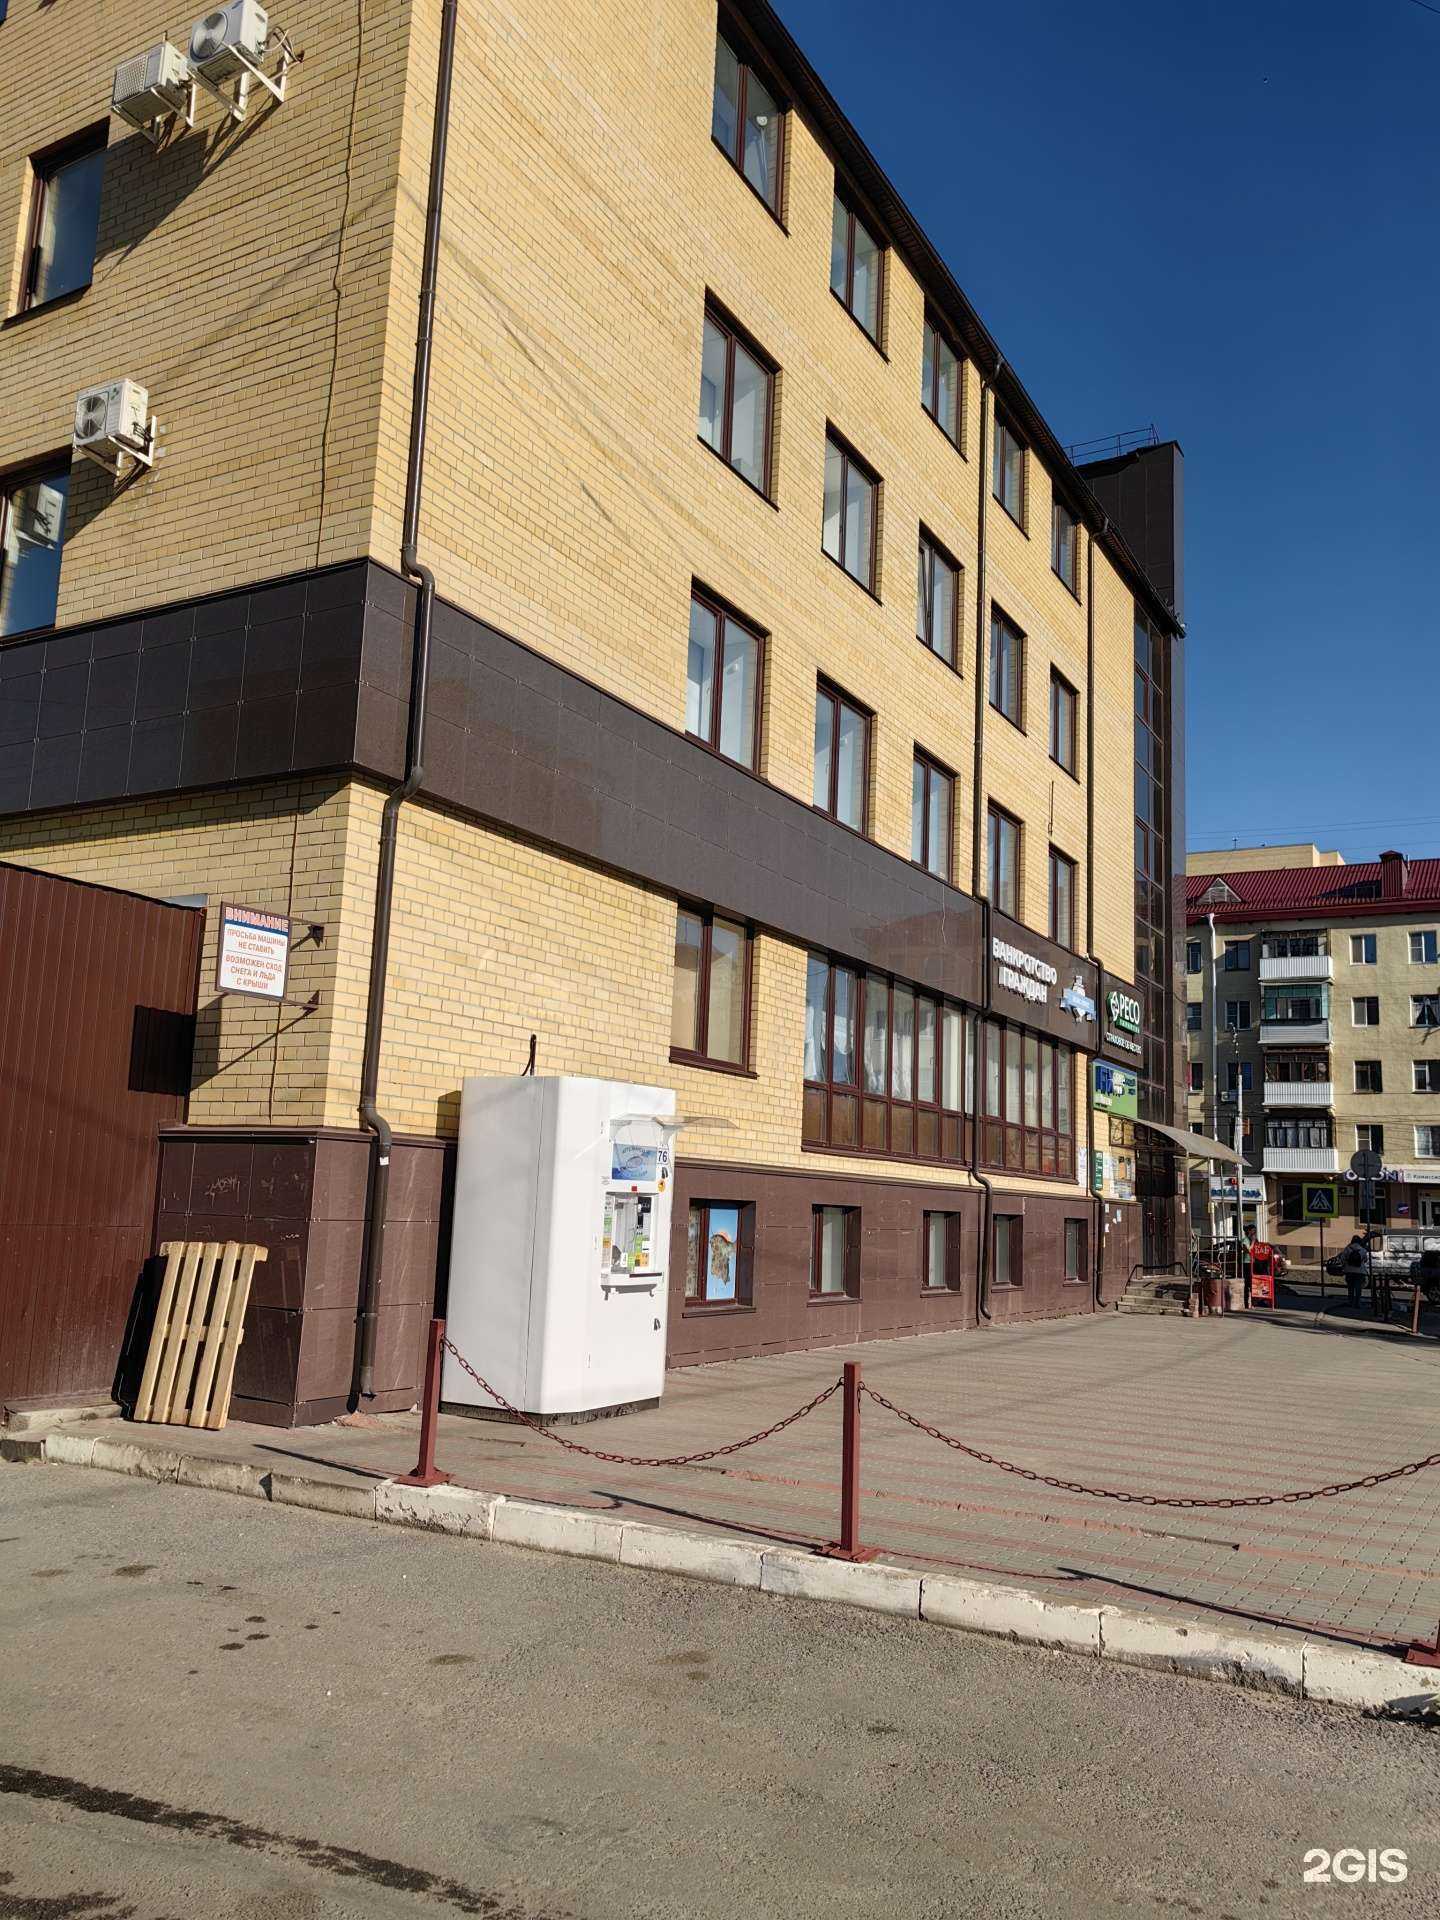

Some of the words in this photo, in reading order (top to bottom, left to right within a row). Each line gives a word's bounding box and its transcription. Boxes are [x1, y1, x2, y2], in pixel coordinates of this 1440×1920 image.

[225, 906, 289, 932] ВНИМАНИЕ
[226, 928, 257, 941] ПРОСЬБА
[258, 935, 286, 947] МАШИНЫ
[238, 941, 247, 950] НЕ
[248, 943, 275, 955] СТАВИТЬ
[225, 954, 264, 970] ВОЗМОЖЕН
[265, 962, 282, 973] СХОД
[992, 937, 1058, 985] БАНКРОТСТВО
[230, 965, 252, 977] СНЕГА
[253, 970, 259, 978] И
[260, 971, 276, 982] ЛЬДА
[236, 977, 242, 985] С
[243, 978, 268, 990] КРЫШИ
[998, 966, 1048, 1003] ГРАЖДАН
[658, 1150, 668, 1163] 76
